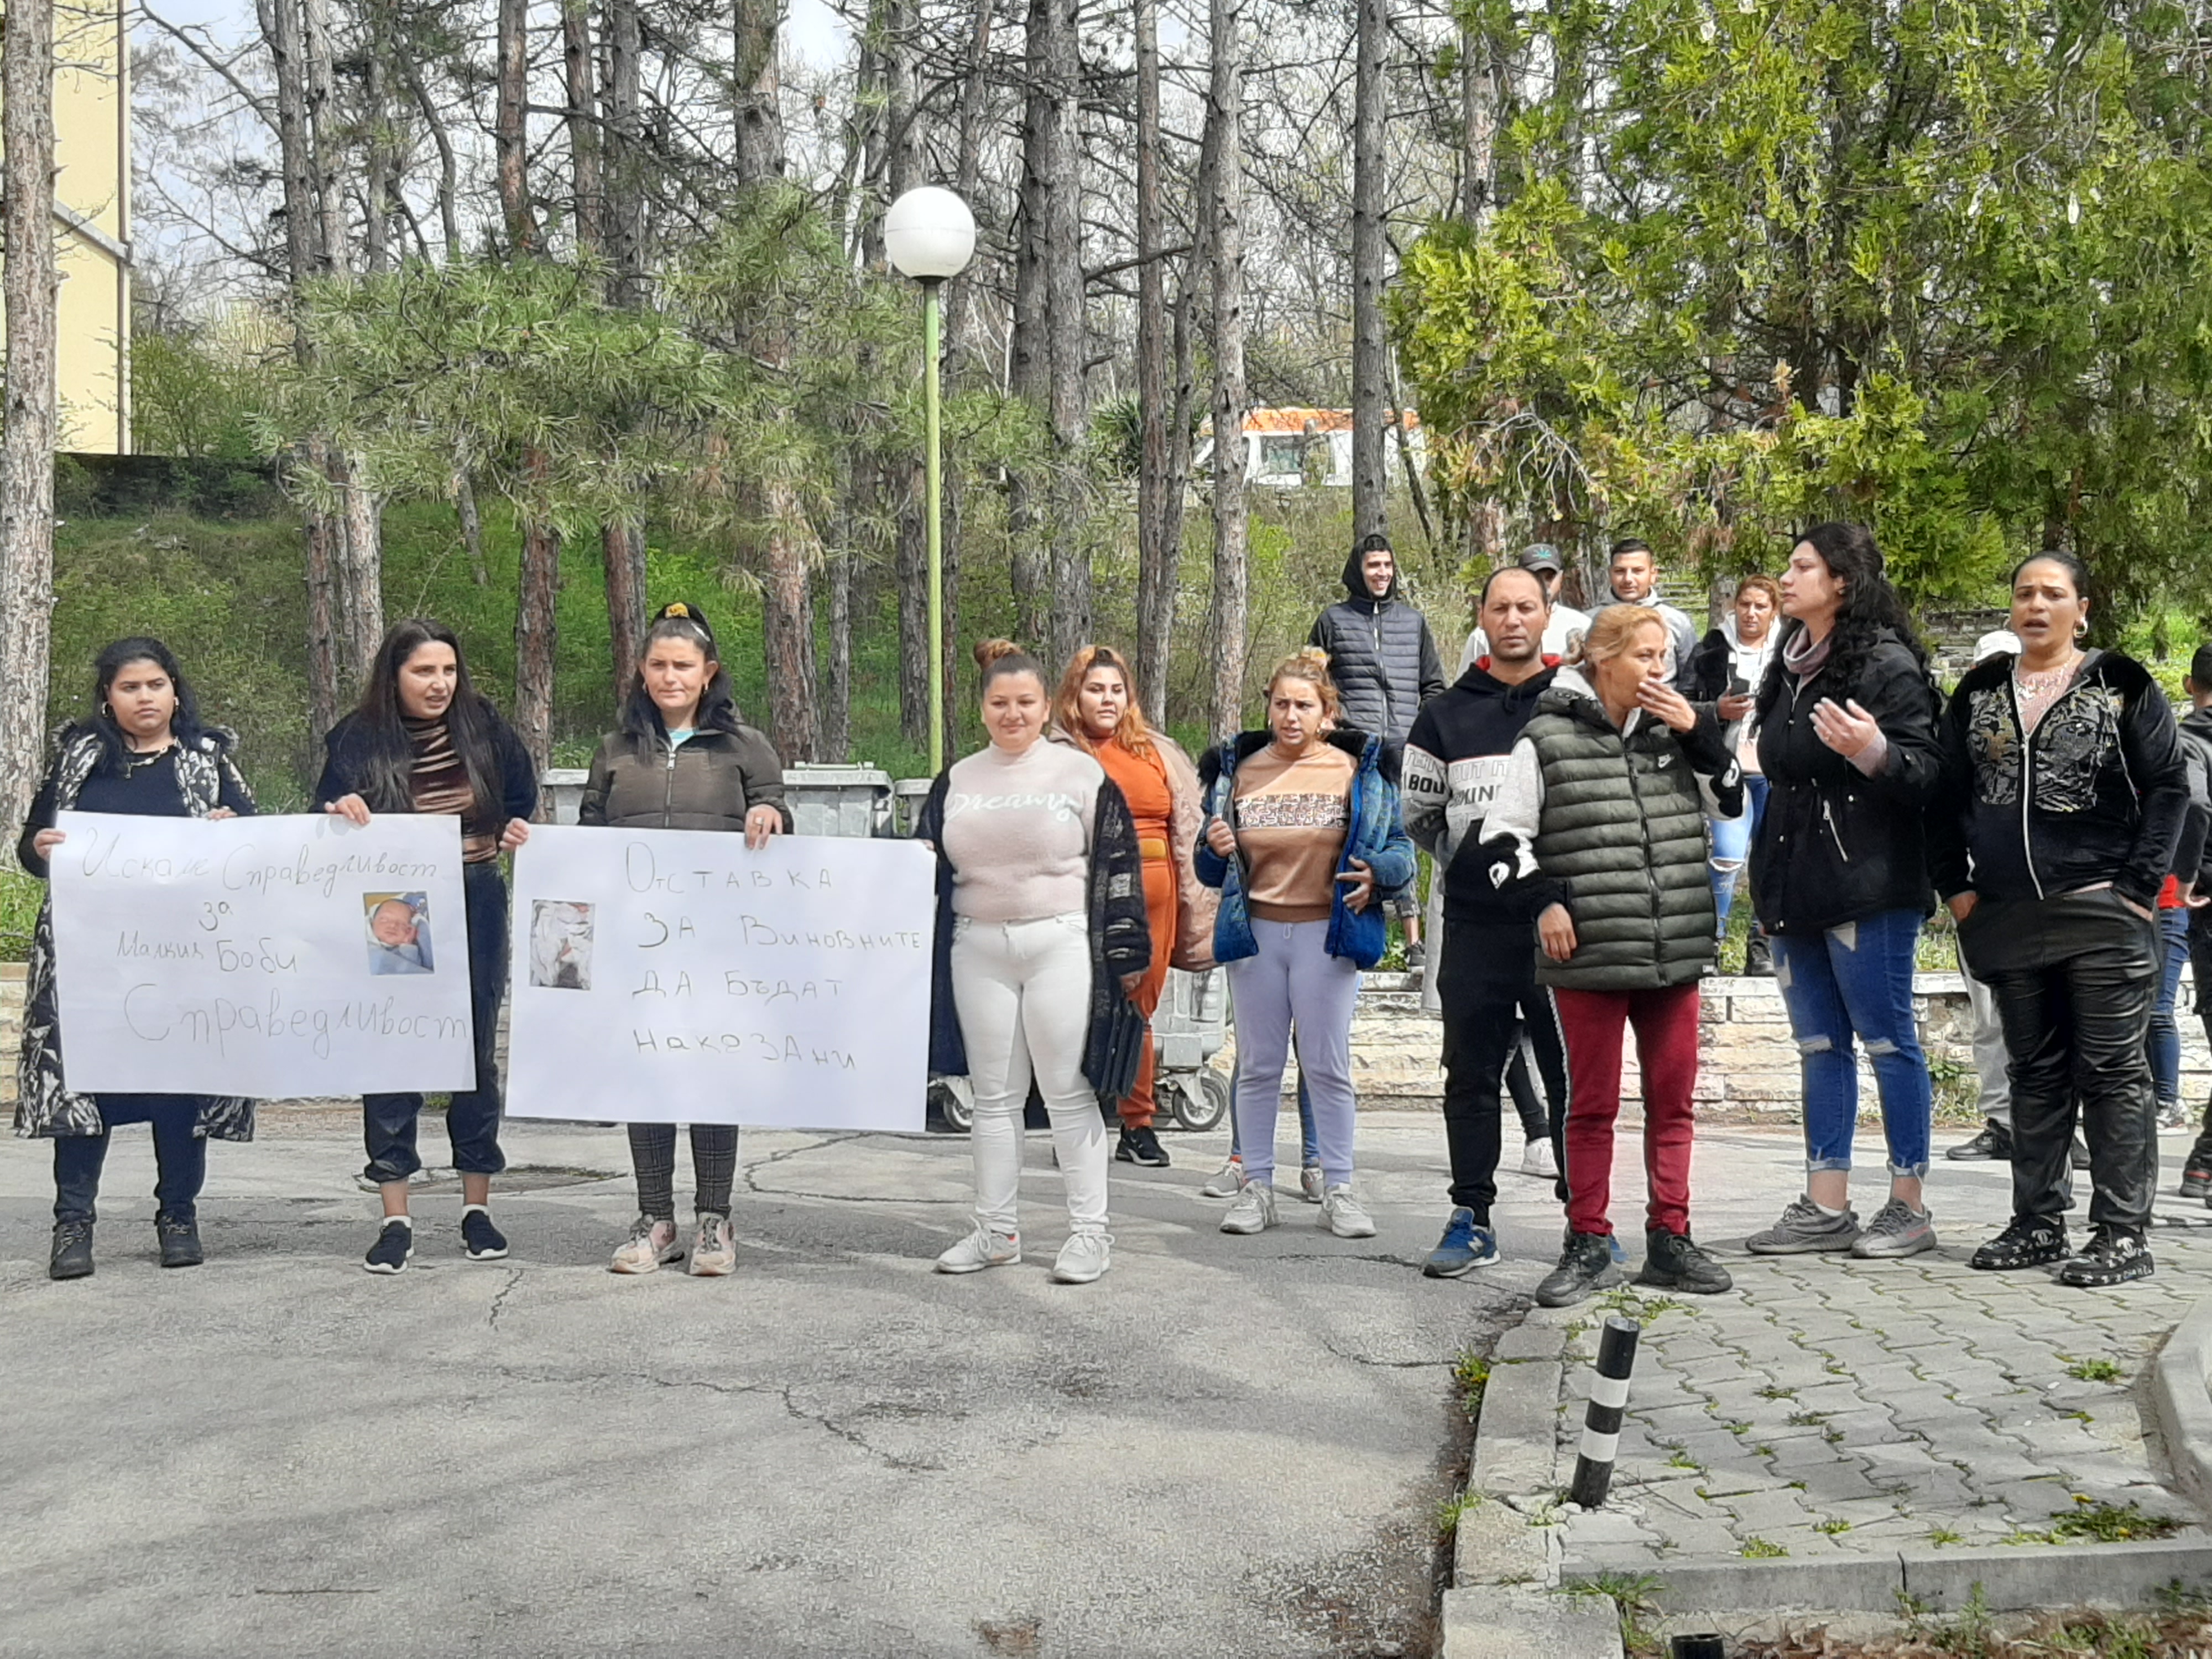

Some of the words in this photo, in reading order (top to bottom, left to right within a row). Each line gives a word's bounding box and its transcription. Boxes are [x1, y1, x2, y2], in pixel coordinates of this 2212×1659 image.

[222, 843, 437, 899] Справедливост
[638, 911, 696, 948] ЗА
[216, 937, 298, 973] Боби
[632, 969, 693, 999] ДА
[123, 983, 469, 1060] Справедливост
